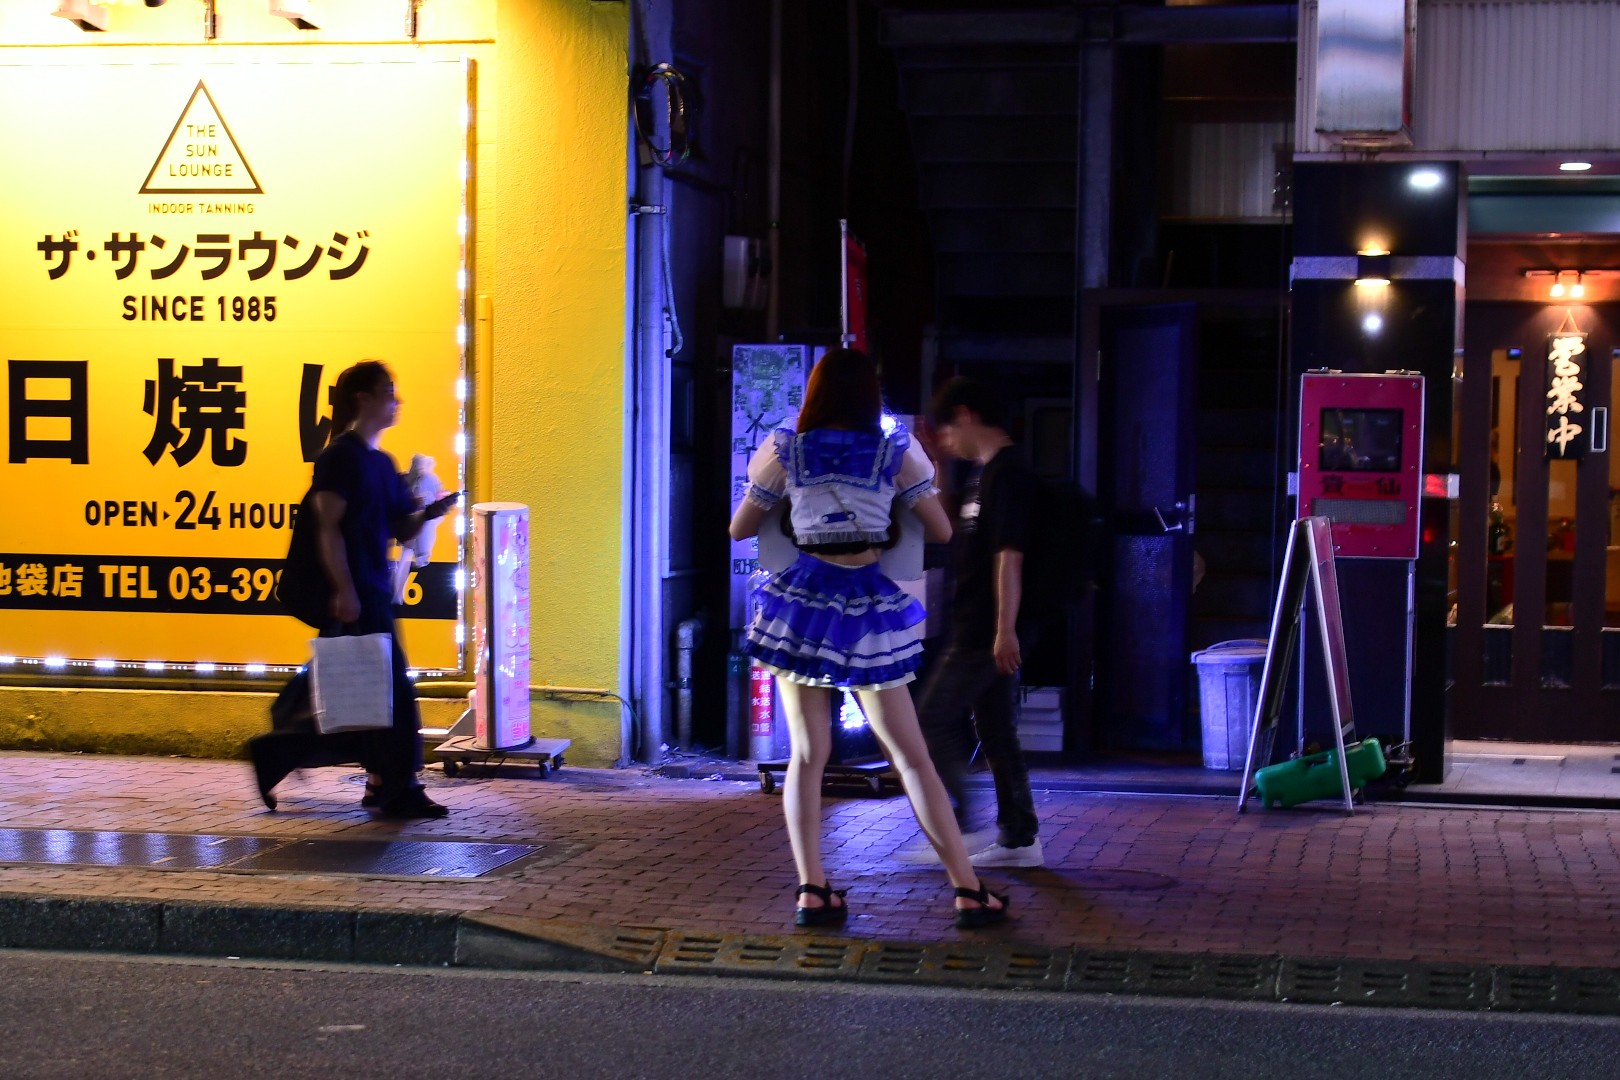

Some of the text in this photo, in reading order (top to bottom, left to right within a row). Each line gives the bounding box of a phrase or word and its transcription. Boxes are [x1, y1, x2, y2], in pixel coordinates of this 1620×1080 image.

[186, 124, 216, 138] THE
[186, 144, 218, 157] SUN
[169, 163, 233, 177] LOUNGE
[148, 203, 255, 214] INDOOR TANNING
[37, 229, 370, 281] ザ・サンラウンジ
[122, 295, 277, 322] SINCE 1985
[85, 500, 158, 527] OPEN
[174, 490, 221, 530] 24
[99, 565, 157, 599] TEL
